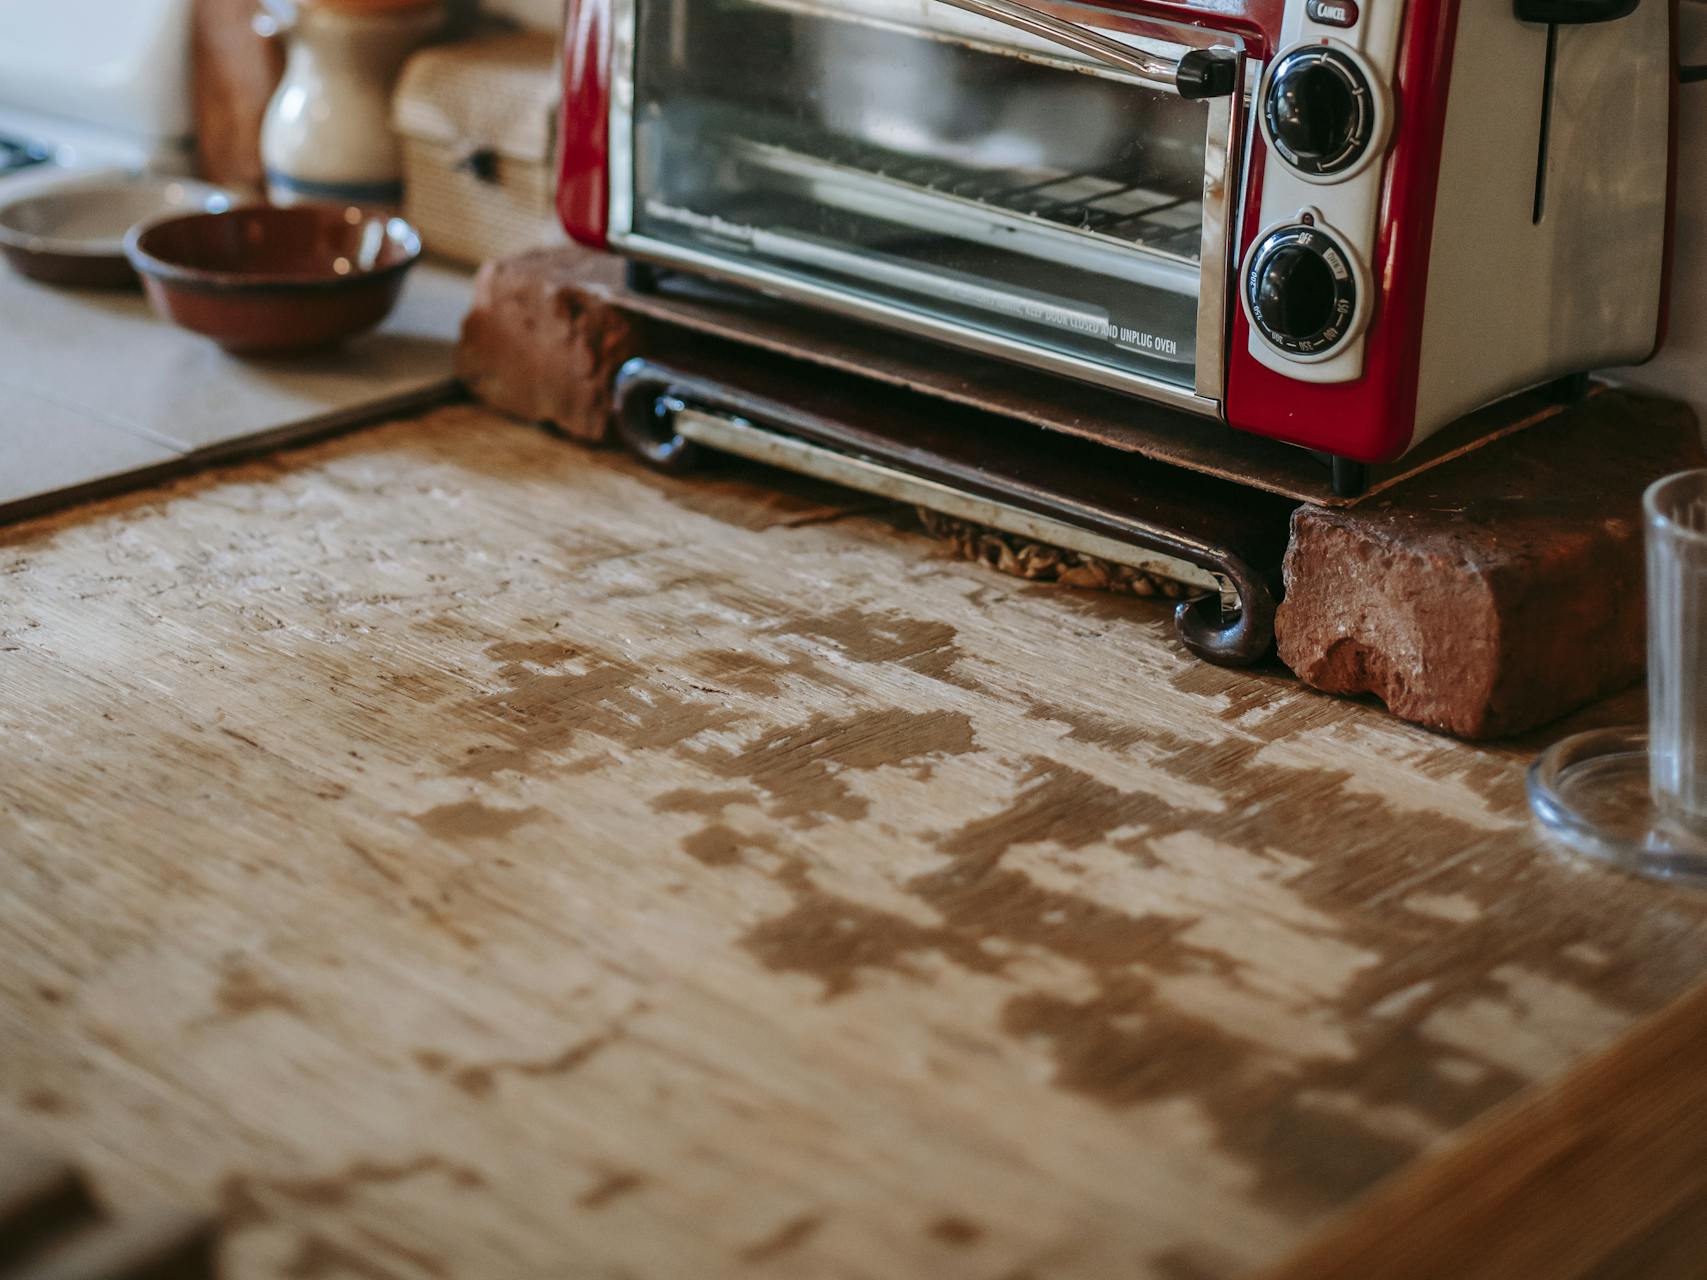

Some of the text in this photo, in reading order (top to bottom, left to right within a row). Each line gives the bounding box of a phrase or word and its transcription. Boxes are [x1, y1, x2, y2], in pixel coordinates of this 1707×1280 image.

[1317, 2, 1346, 21] CANCEL
[1298, 232, 1313, 245] OFF
[1254, 306, 1263, 320] 250
[1070, 315, 1099, 334] CLOSED
[1100, 322, 1118, 339] AND
[1120, 327, 1153, 348] UNPLUG
[1154, 336, 1177, 355] OVEN
[1272, 331, 1284, 345] 300
[1299, 341, 1314, 351] 350
